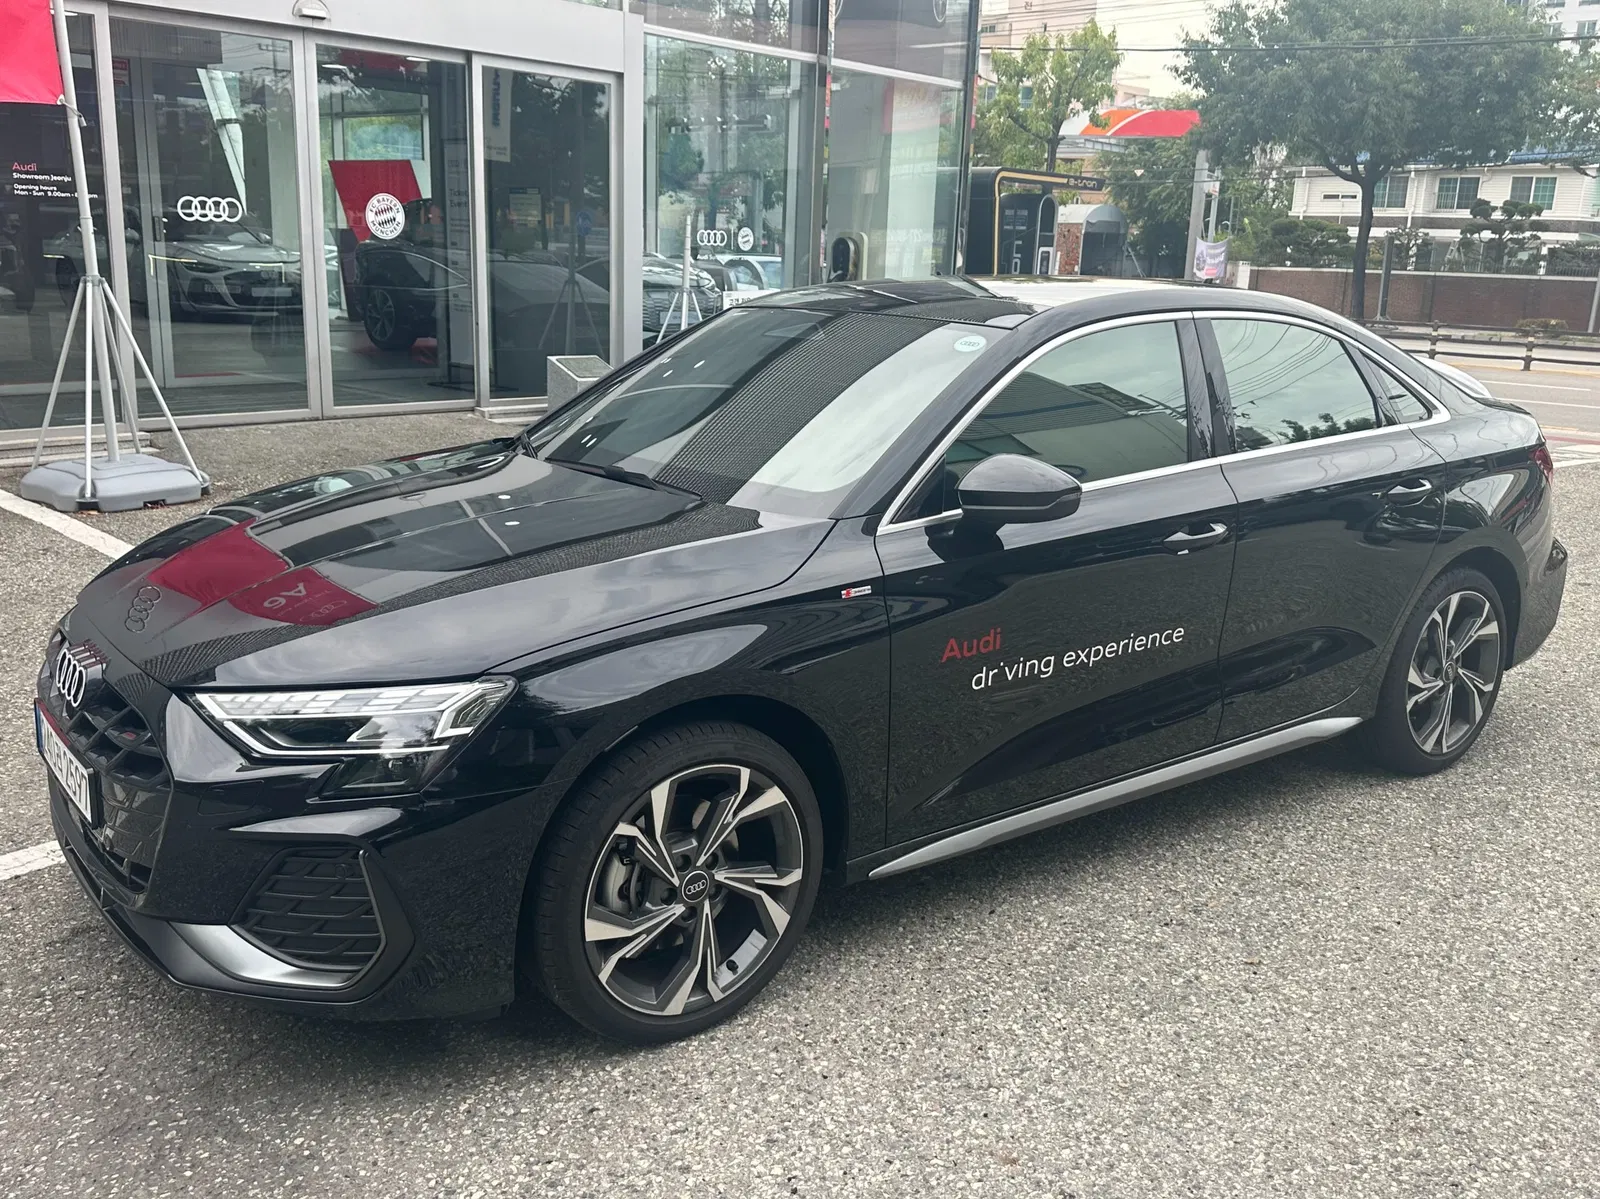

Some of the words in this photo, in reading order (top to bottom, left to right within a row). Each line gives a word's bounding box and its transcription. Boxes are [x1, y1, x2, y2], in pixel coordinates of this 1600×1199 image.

[12, 162, 37, 171] Audi
[12, 172, 50, 181] Showroom
[13, 183, 39, 191] Opening
[263, 582, 307, 609] A6
[941, 628, 1001, 662] Audi
[971, 656, 1055, 690] drving
[1062, 627, 1185, 667] experience
